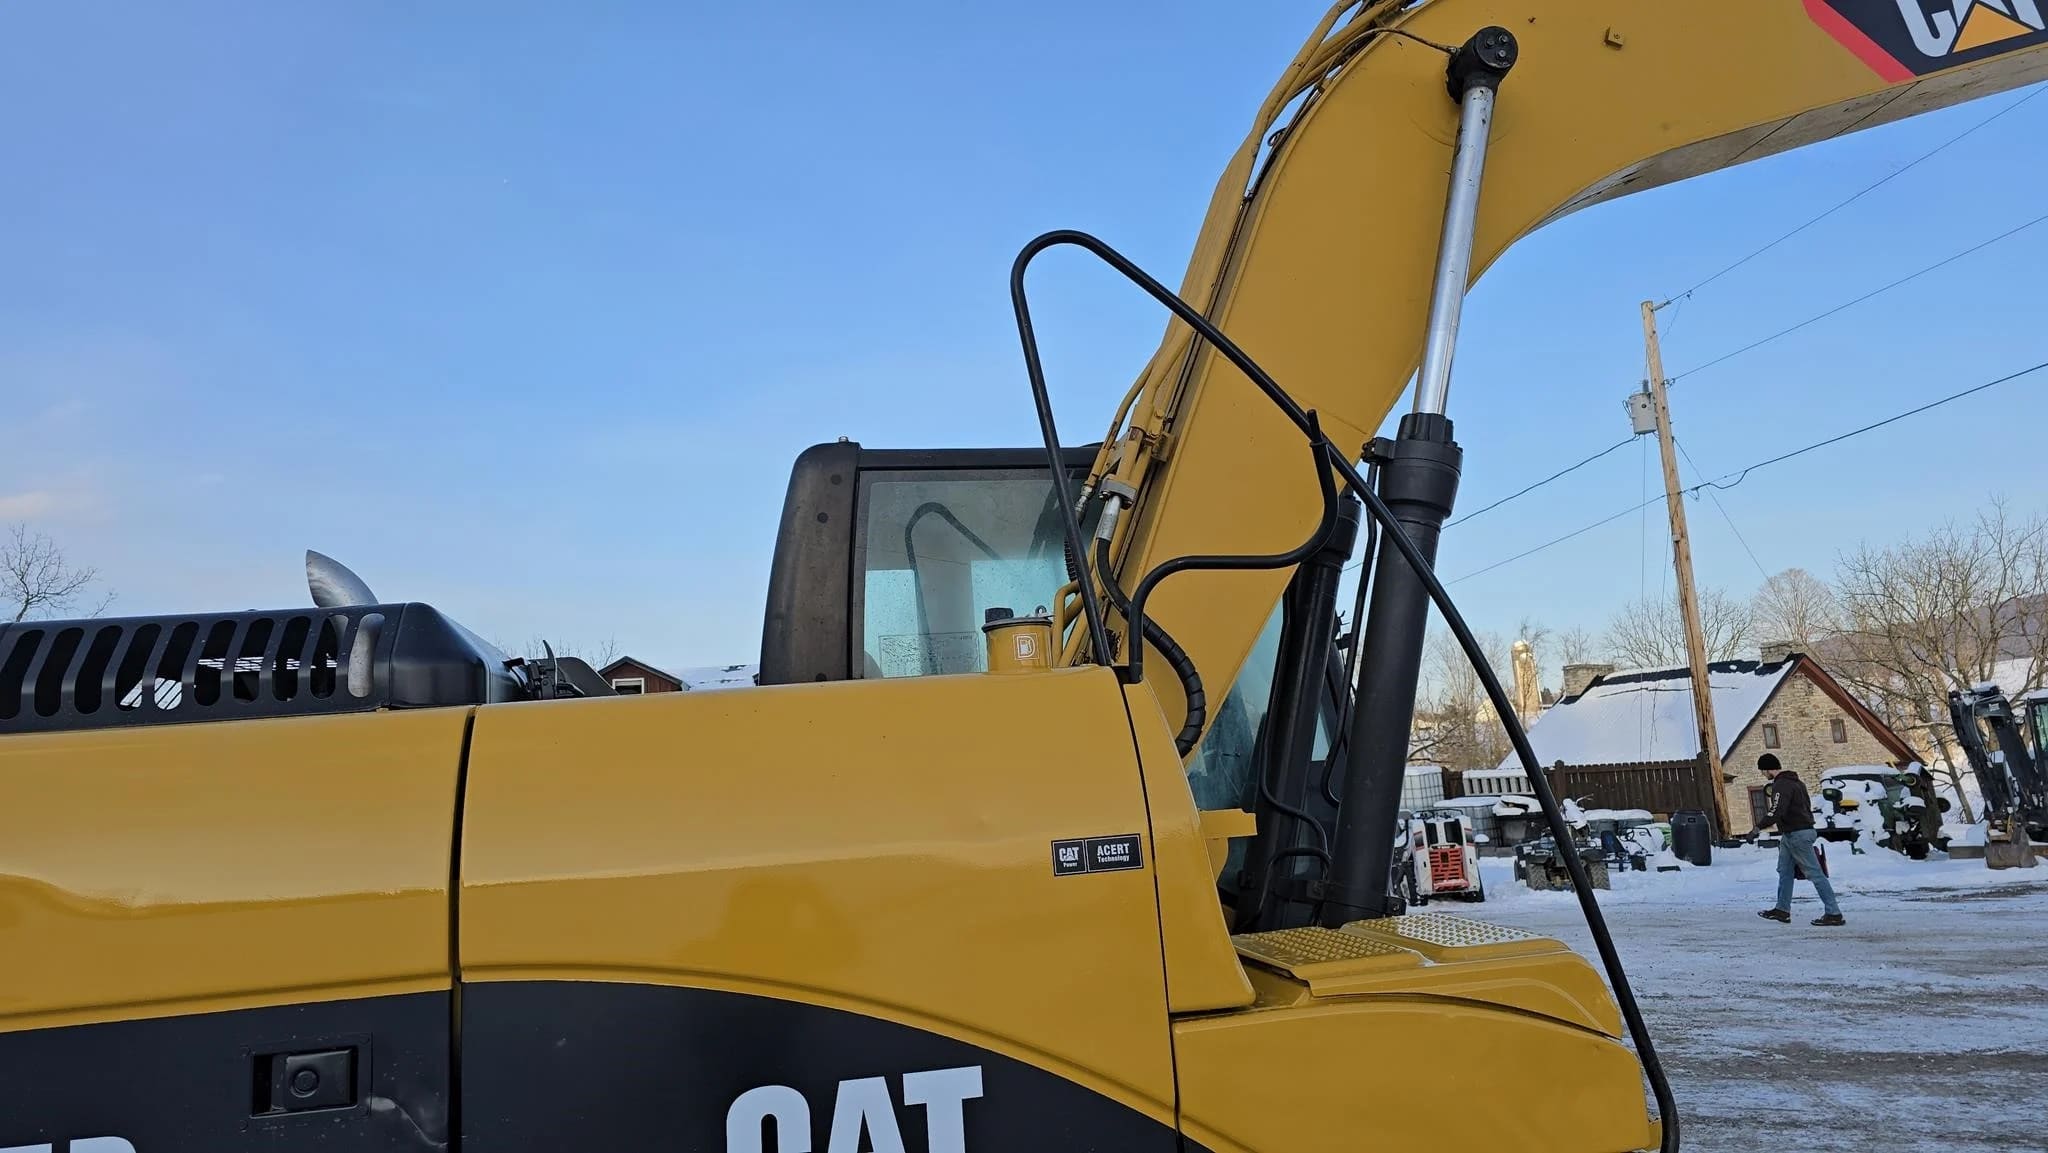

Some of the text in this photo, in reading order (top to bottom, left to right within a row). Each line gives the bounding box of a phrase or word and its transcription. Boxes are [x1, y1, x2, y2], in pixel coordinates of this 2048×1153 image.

[1059, 846, 1079, 862] CAT
[1097, 843, 1130, 856] ACERT
[1097, 854, 1130, 863] Technology
